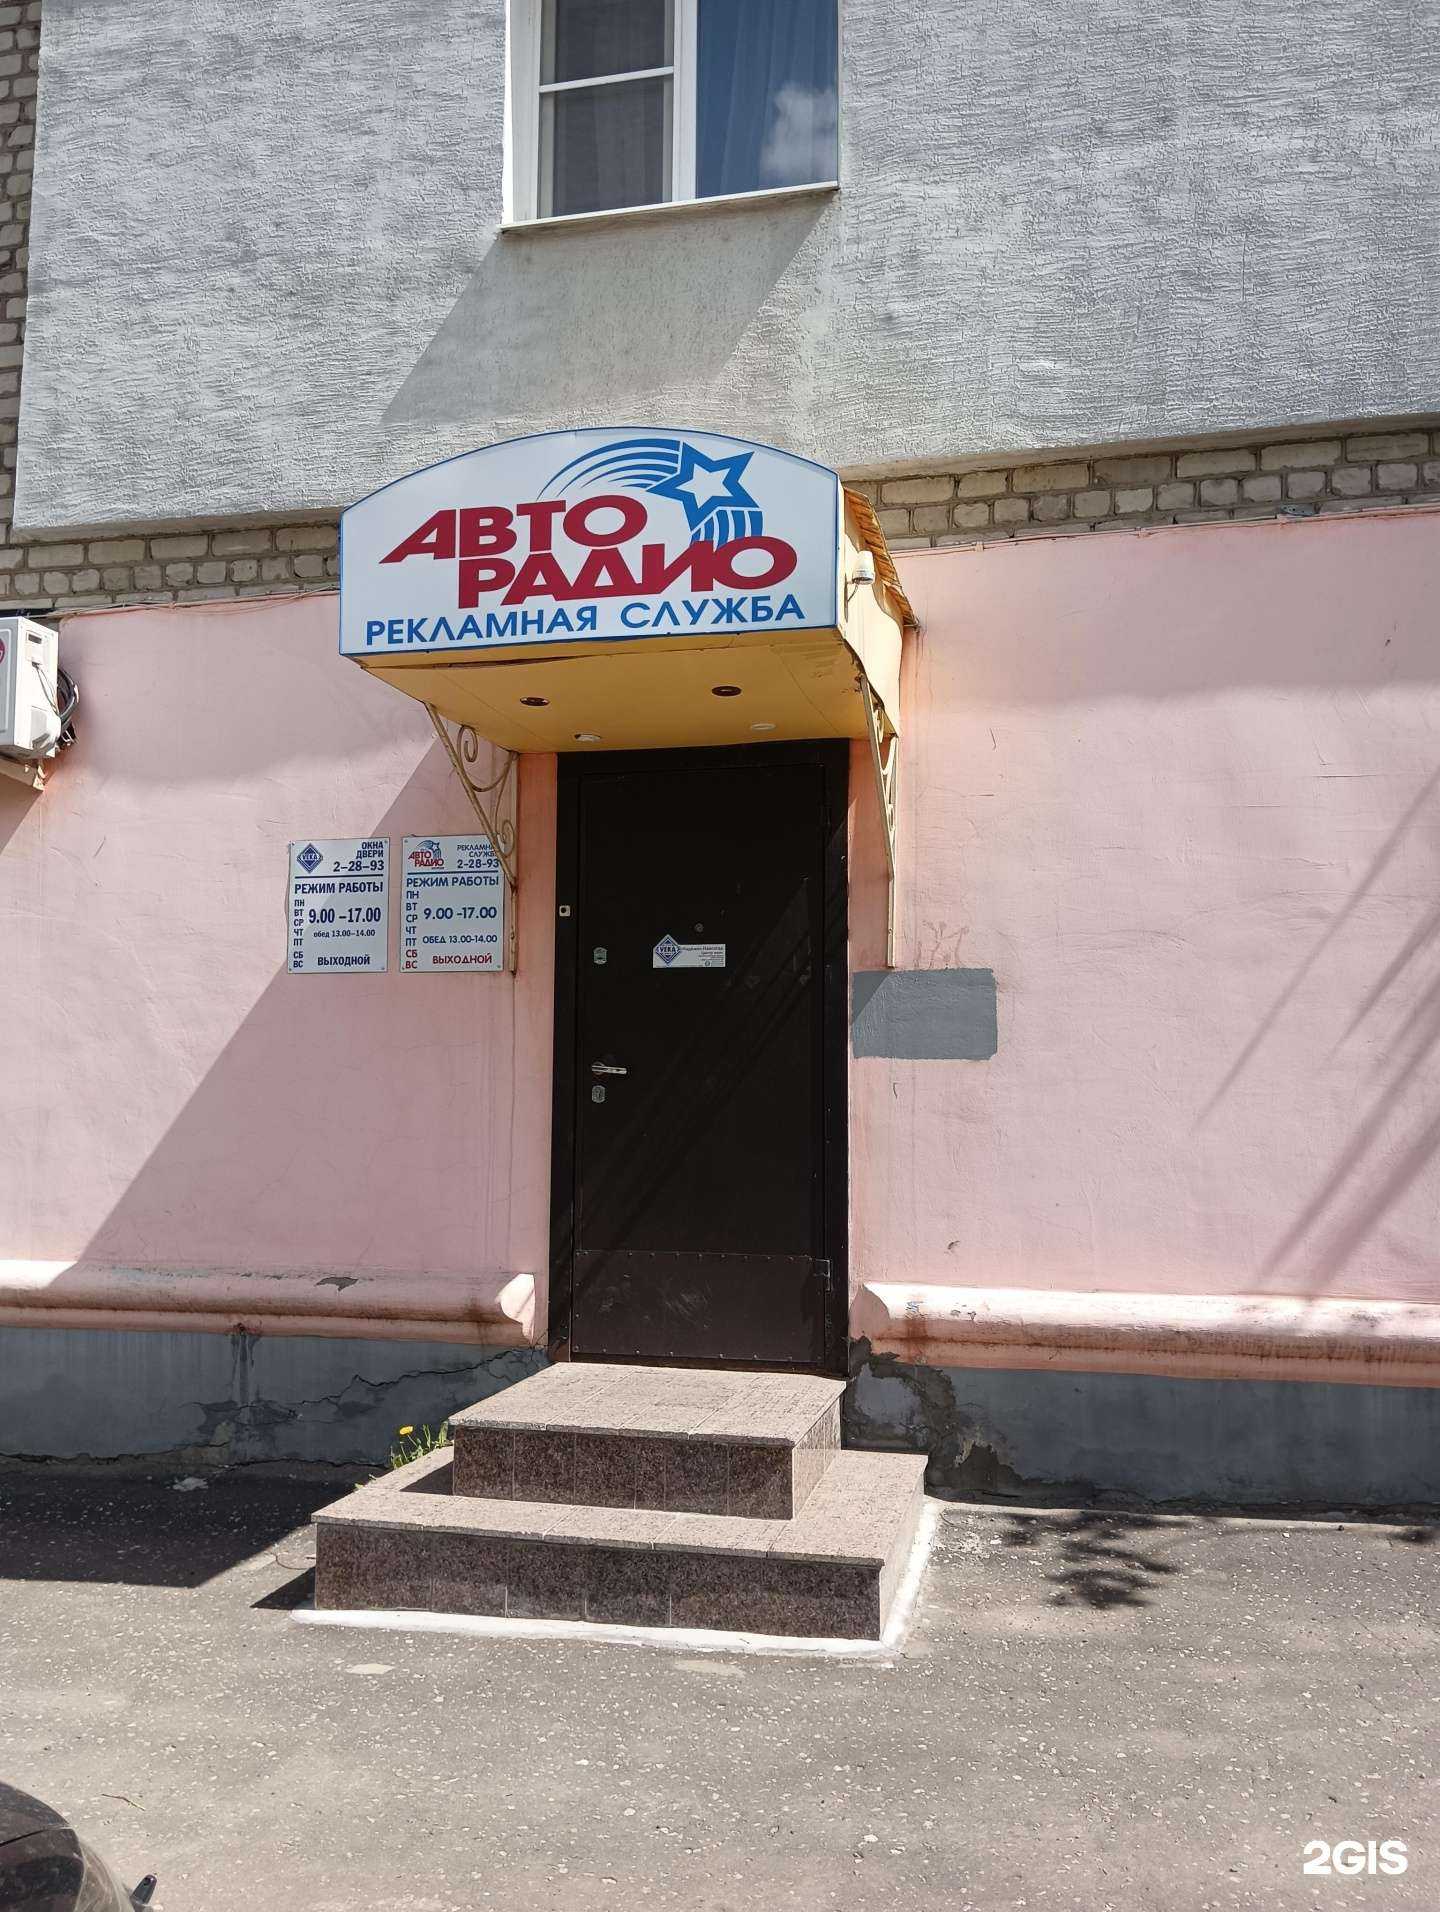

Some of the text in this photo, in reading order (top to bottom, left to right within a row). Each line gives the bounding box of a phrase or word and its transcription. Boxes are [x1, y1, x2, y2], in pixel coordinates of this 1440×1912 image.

[379, 494, 648, 565] АВТО
[457, 535, 798, 609] РАДИО
[366, 594, 806, 646] РЕКЛАМНАЯ СЛУЖБА
[361, 841, 384, 850] ОКНА
[355, 849, 384, 859] ДВЕРИ
[408, 850, 431, 860] АВТО
[415, 858, 444, 867] РАДИО
[457, 858, 499, 869] 2-28-93
[406, 876, 499, 887] РЕЖИМ РАБОТЫ
[294, 881, 384, 894] РЕЖИМ РАБОТЫ
[406, 890, 419, 899] ПН
[294, 899, 304, 907] ПН
[406, 902, 418, 911] ВТ
[294, 909, 304, 917] ВТ
[308, 908, 335, 924] 9.00
[423, 907, 453, 920] 9.00
[405, 914, 418, 923] СР
[294, 928, 304, 936] ЧТ
[405, 926, 417, 934] ЧТ
[293, 938, 304, 946] ПТ
[405, 938, 417, 946] ПТ
[422, 935, 498, 944] ОБЕД 13.00-14.00
[293, 951, 304, 959] СБ
[405, 949, 418, 958] СБ
[317, 954, 370, 967] ВЫХОДНОЙ
[432, 953, 493, 964] ВЫХОДНОЙ
[293, 960, 304, 968] ВС
[405, 961, 418, 969] ВС
